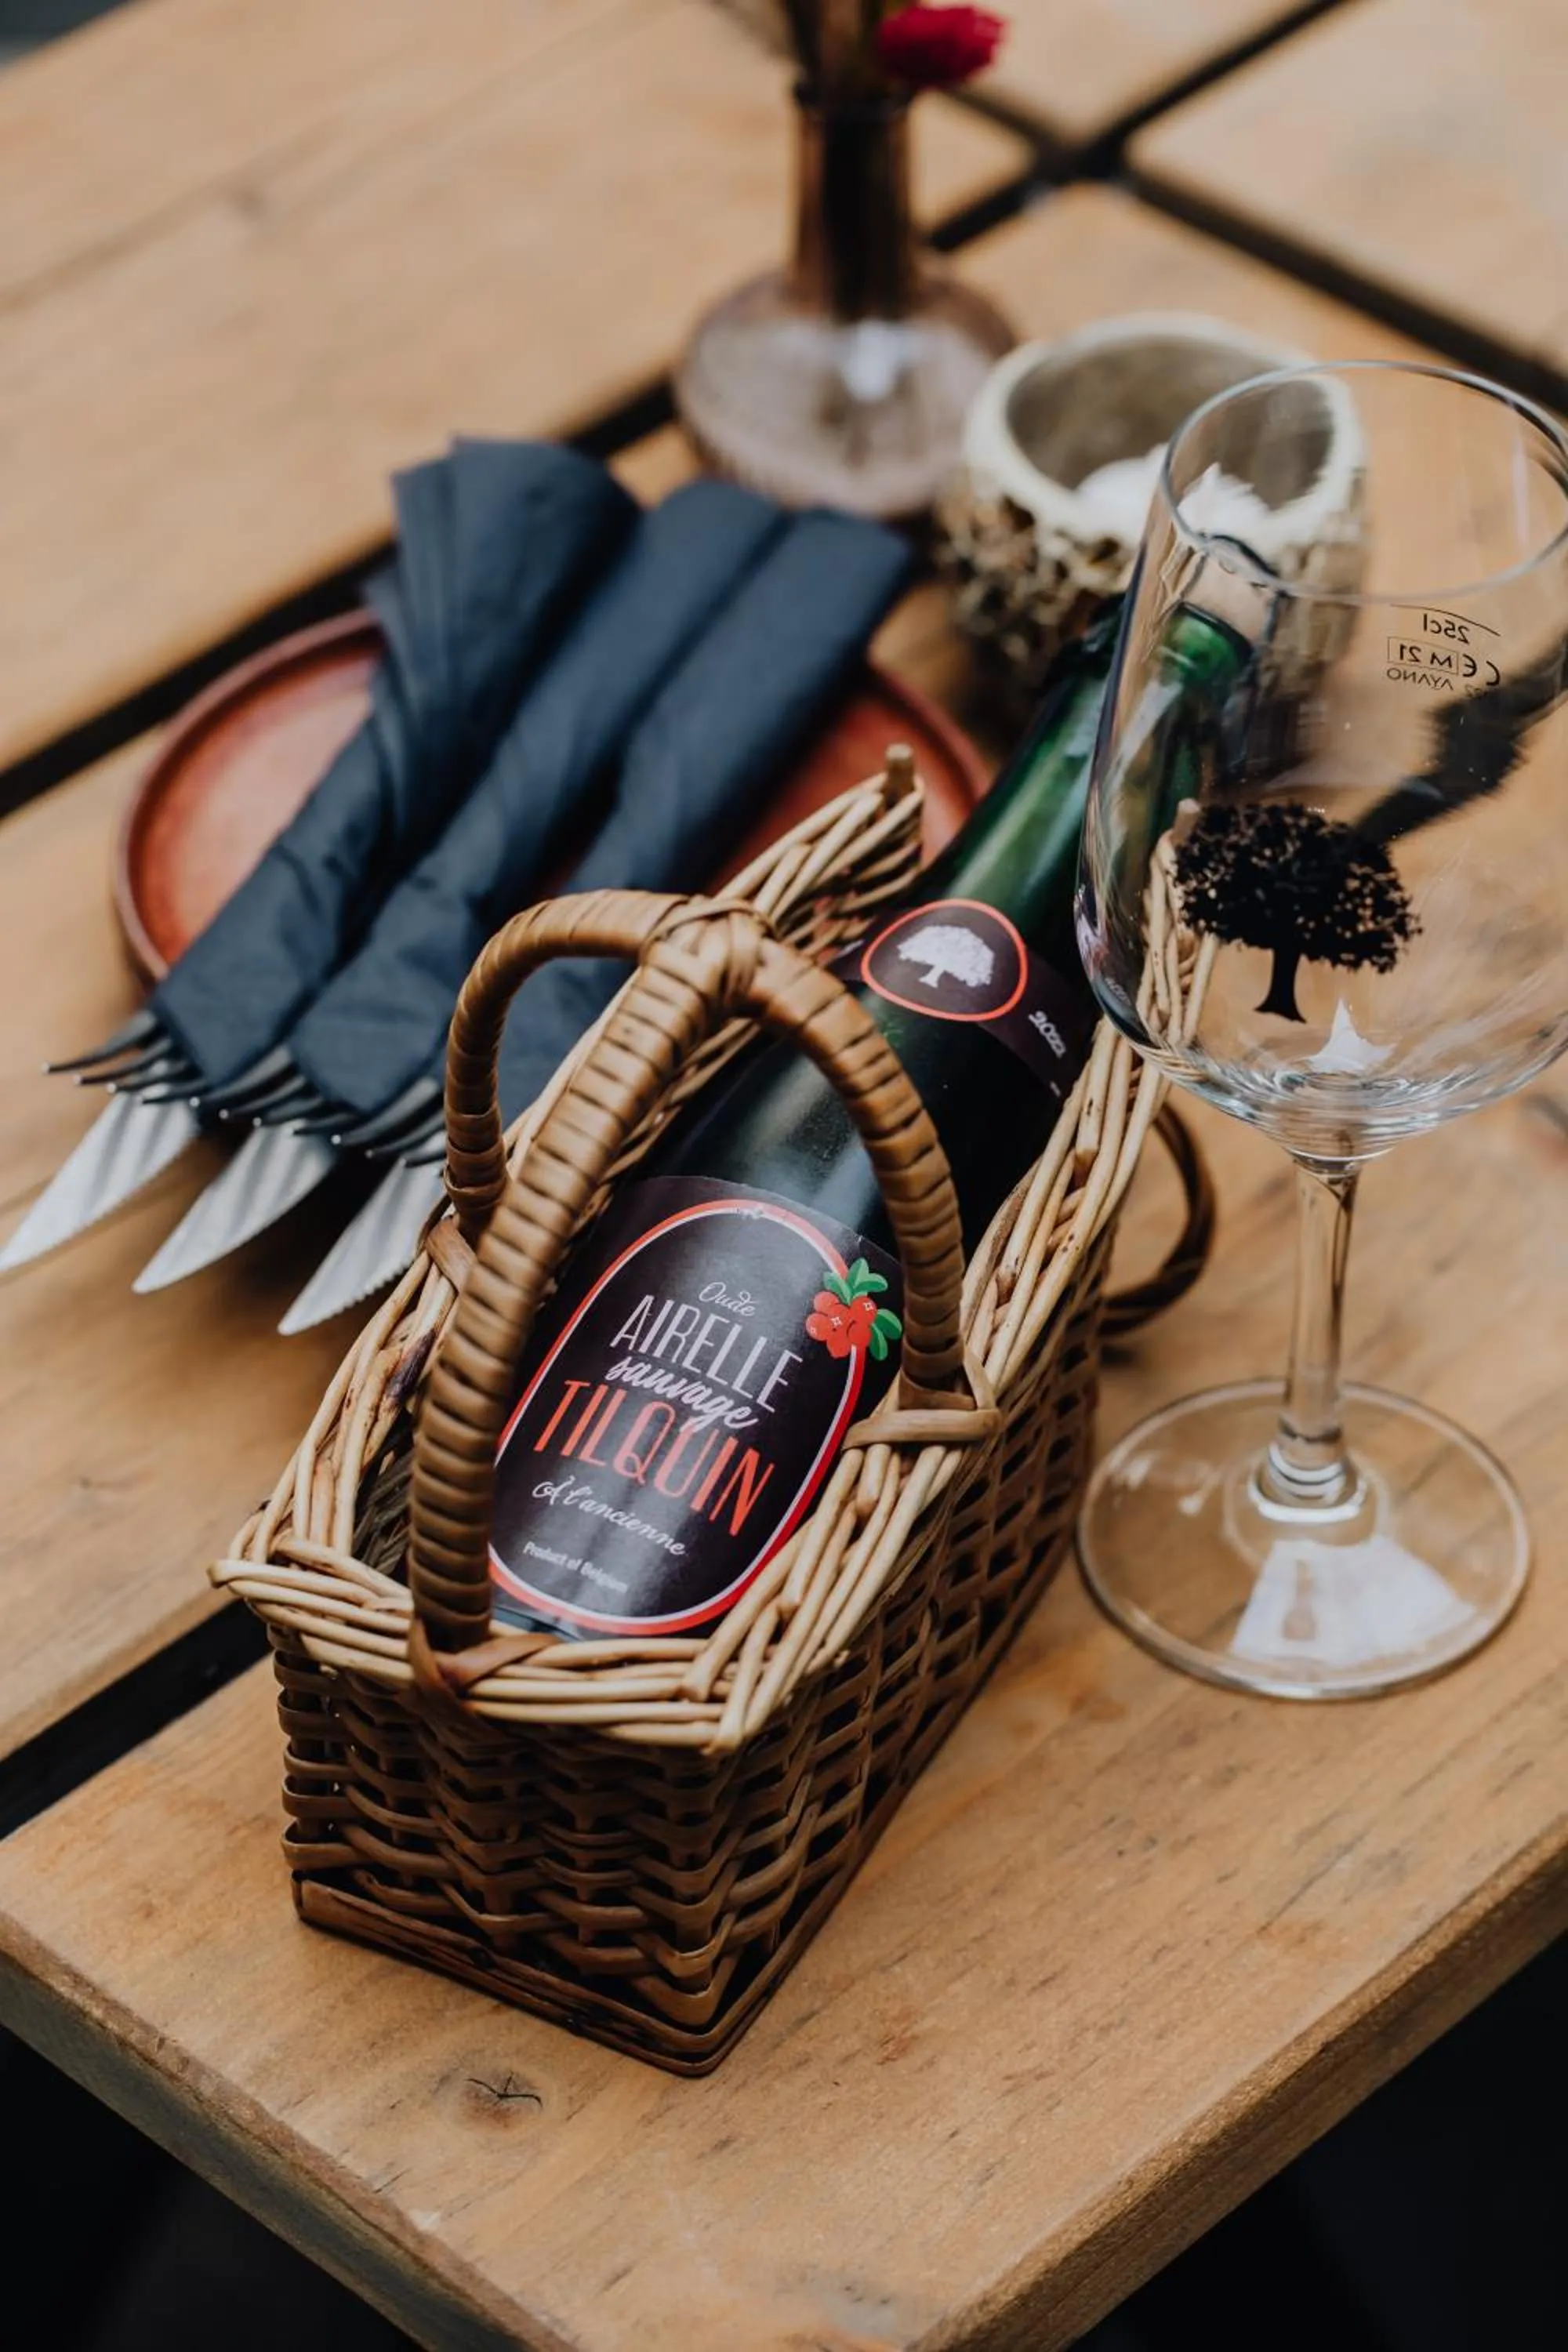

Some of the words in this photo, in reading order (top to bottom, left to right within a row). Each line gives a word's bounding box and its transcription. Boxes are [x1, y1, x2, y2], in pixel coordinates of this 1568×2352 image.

[699, 1282, 756, 1316] Oude
[605, 1356, 758, 1432] sauvage
[611, 1295, 803, 1412] AIRELLE
[535, 1381, 775, 1537] TILQUIN
